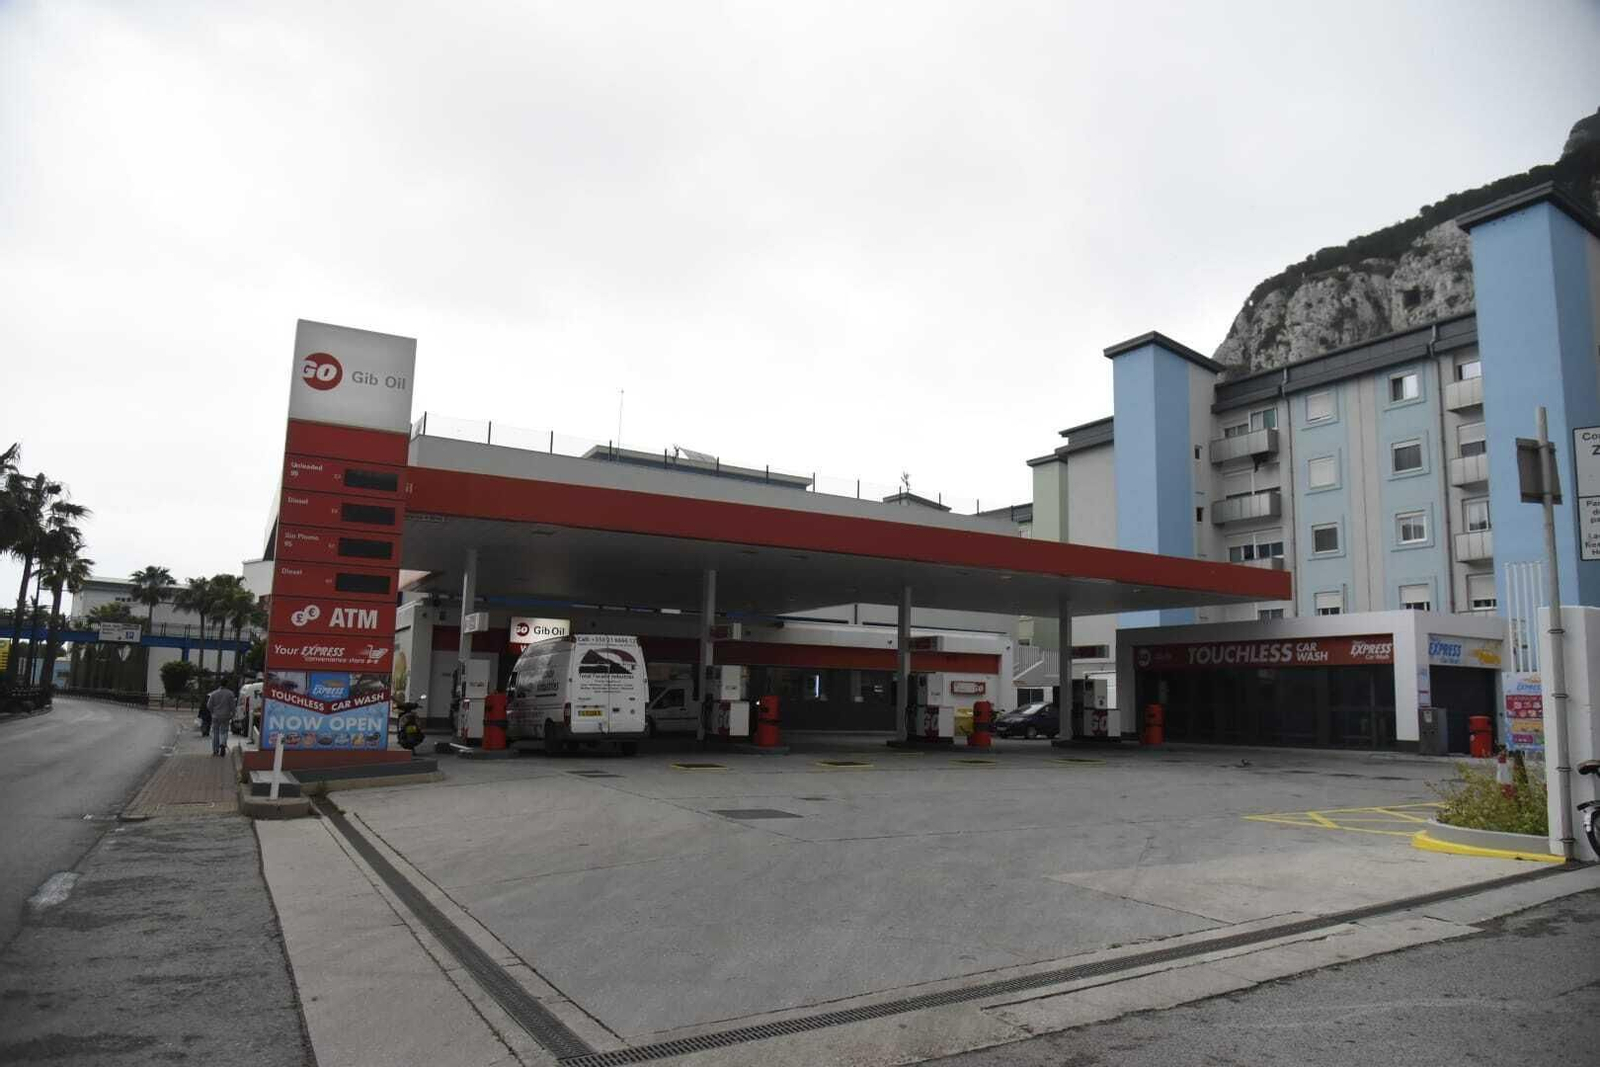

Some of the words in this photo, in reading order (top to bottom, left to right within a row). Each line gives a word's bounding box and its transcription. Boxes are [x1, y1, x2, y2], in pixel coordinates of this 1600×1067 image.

[300, 359, 338, 381] GO
[352, 371, 378, 386] Gib
[384, 376, 406, 390] Oil
[329, 608, 379, 629] ATM
[534, 626, 550, 636] Gib
[551, 627, 565, 636] Oil
[274, 643, 300, 657] Your
[301, 645, 346, 658] EXPRESS
[1188, 643, 1293, 665] TOUCHLESS
[1296, 642, 1318, 652] CAR
[1351, 643, 1393, 657] EXPRESS
[1429, 641, 1462, 657] EXPRESS
[1296, 650, 1329, 663] WASH
[271, 689, 325, 712] TOUCHLESS
[331, 701, 351, 712] CAR
[354, 691, 385, 707] WASH
[269, 715, 323, 732] NOW
[329, 716, 382, 732] OPEN
